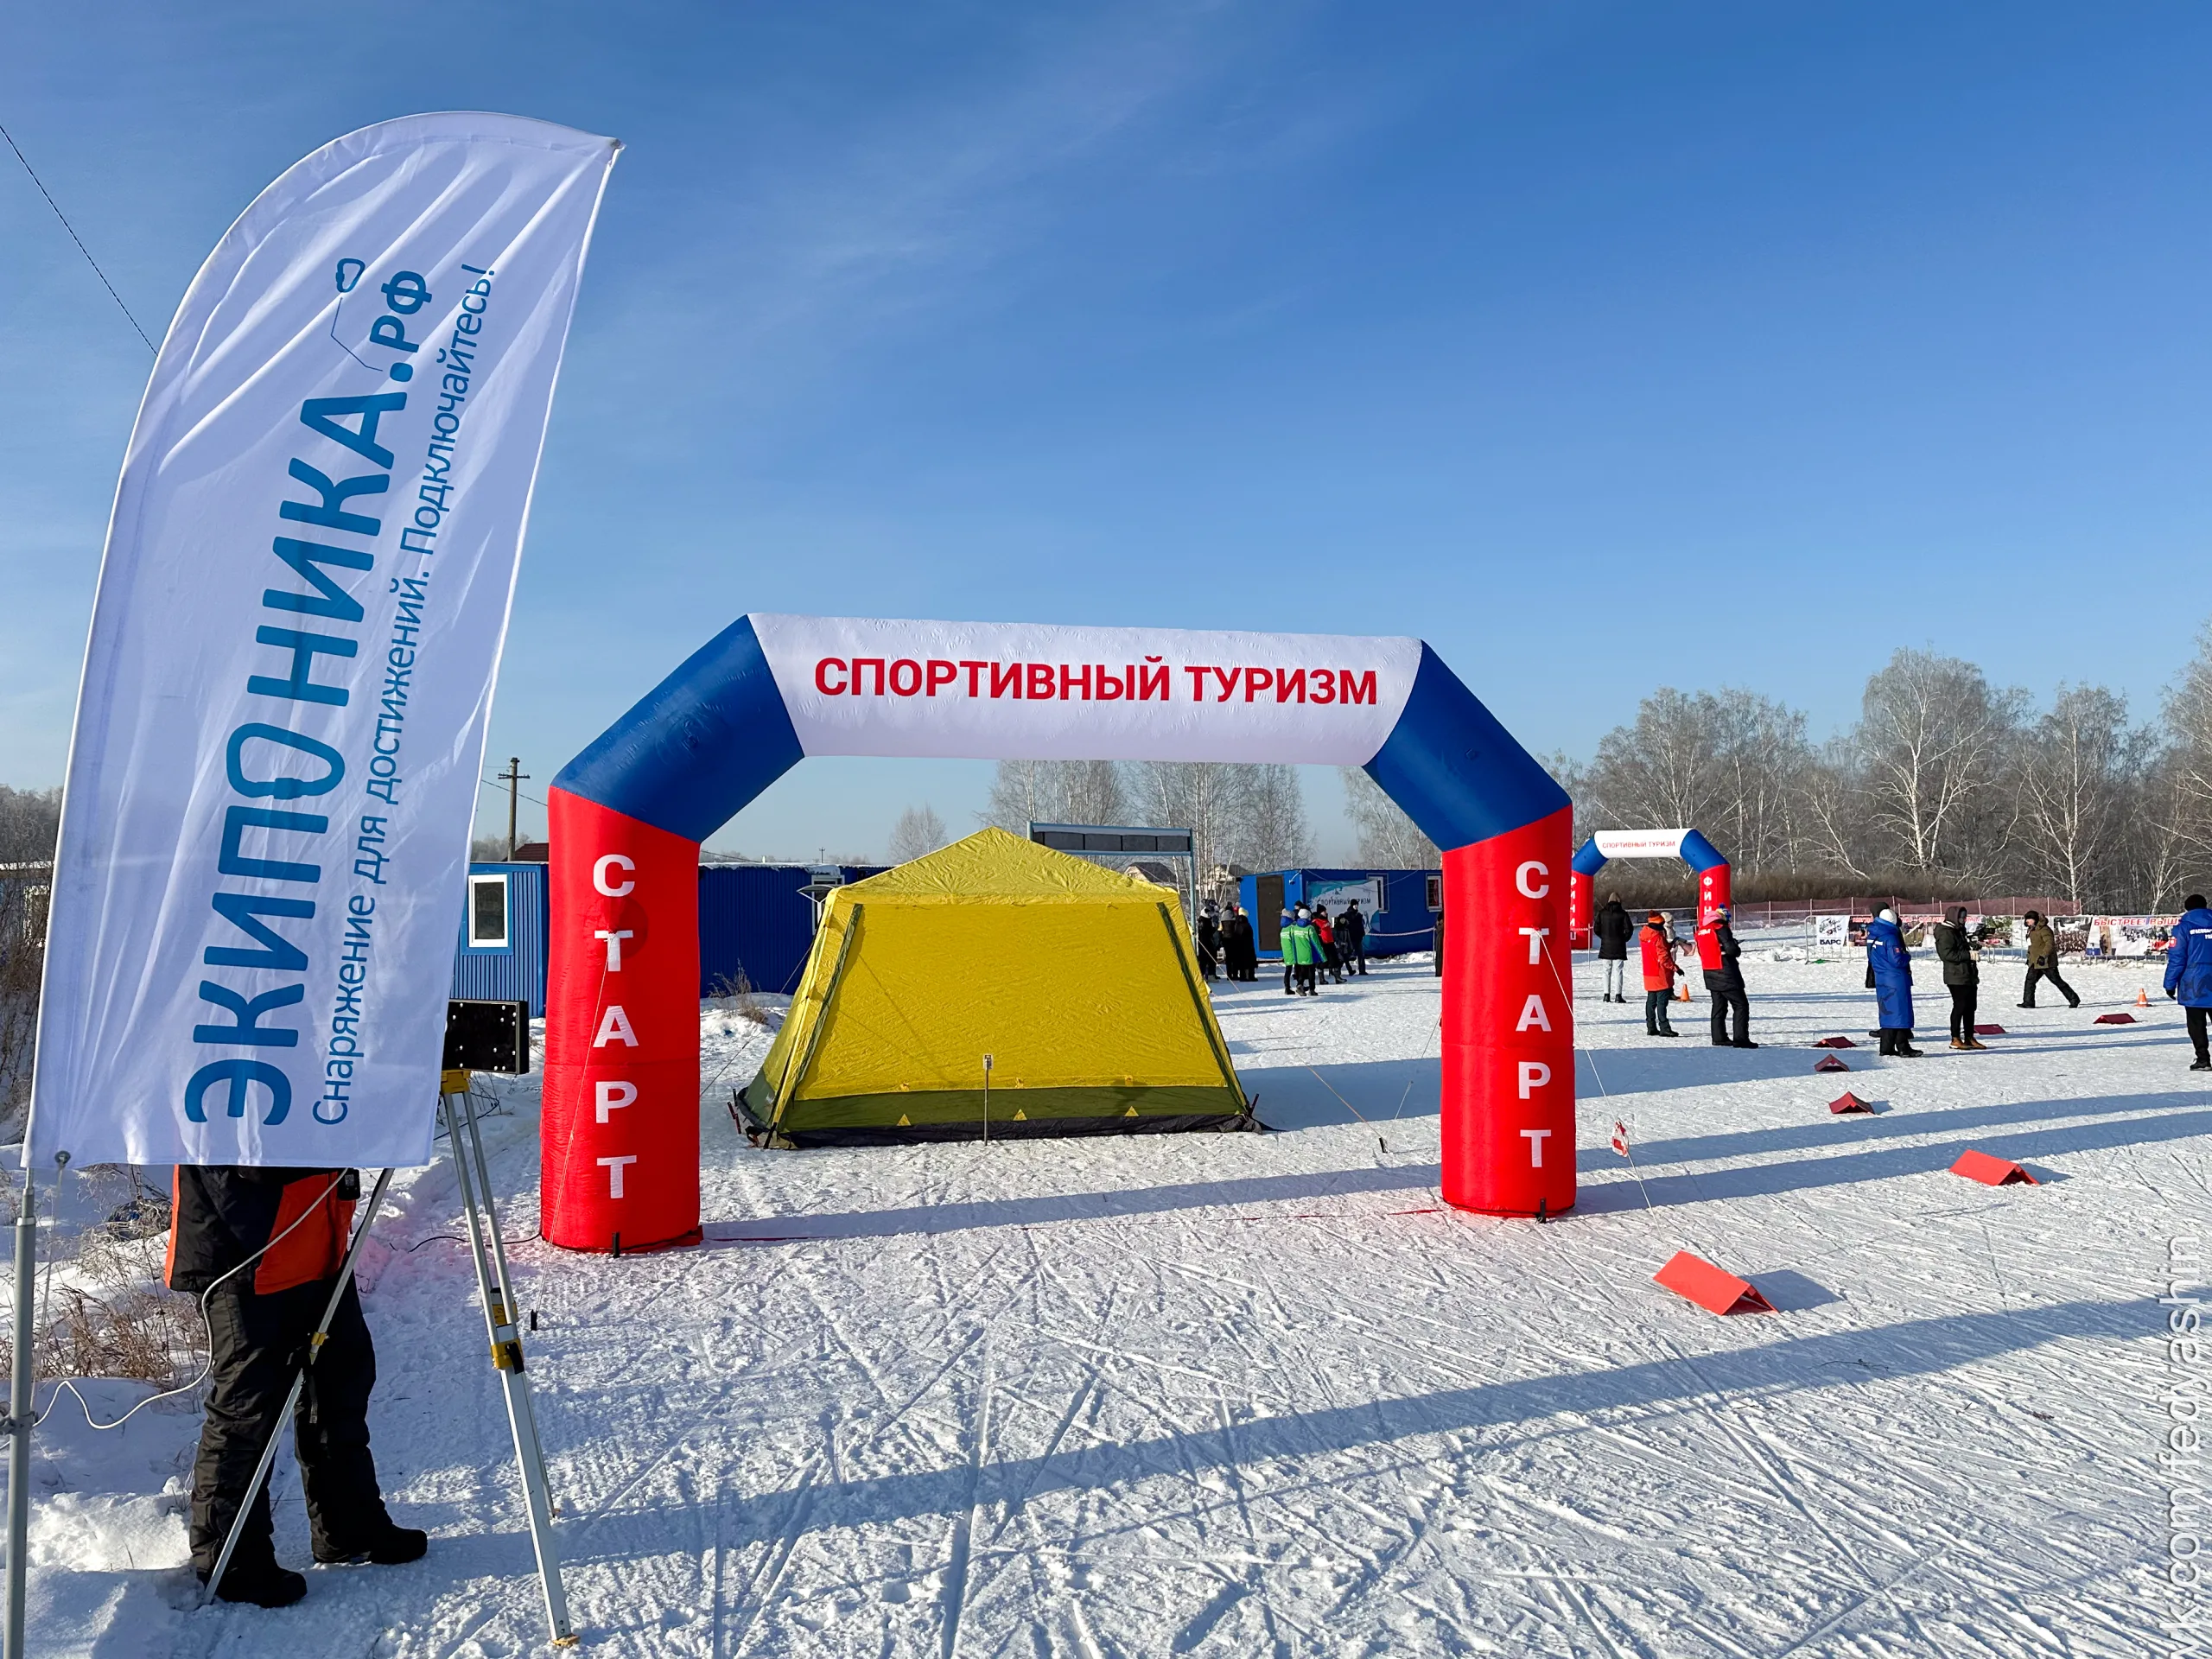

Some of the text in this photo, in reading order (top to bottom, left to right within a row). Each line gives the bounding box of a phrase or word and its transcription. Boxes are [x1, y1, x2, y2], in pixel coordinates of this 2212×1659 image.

[184, 269, 433, 1126] ЭКИПОНИКА.РФ
[312, 264, 496, 1126] Снаряжение для достижений. Подключайтесь!
[815, 655, 1378, 705] СПОРТИВНЫЙ ТУРИЗМ
[593, 854, 639, 1198] СТАРТ
[1516, 861, 1552, 1168] СТАРТ
[2094, 917, 2182, 926] БЫСТРЕЕ! ВЫШ
